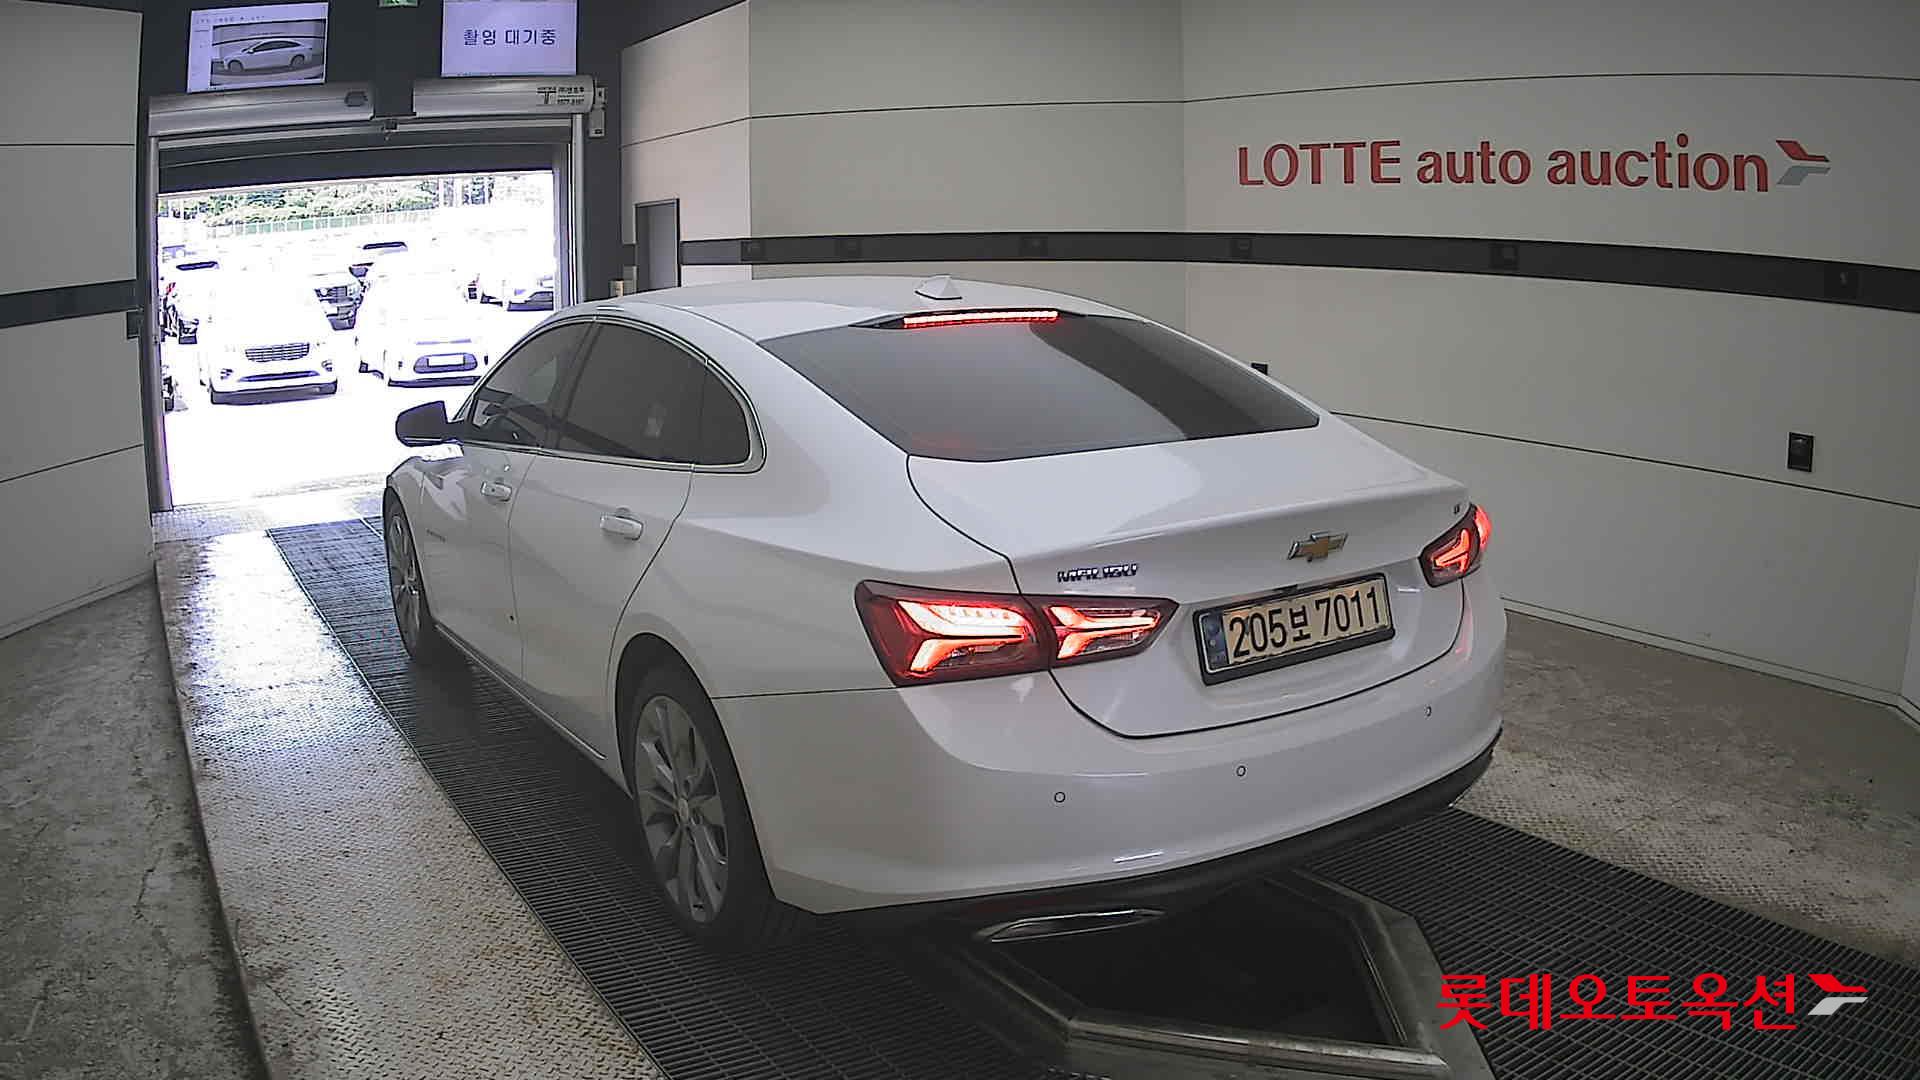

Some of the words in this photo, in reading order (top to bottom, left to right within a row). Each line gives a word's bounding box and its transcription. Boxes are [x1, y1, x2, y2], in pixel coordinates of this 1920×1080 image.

[504, 28, 556, 46] 대기중
[1238, 140, 1401, 187] LOTTE
[1416, 141, 1531, 184] auto
[1547, 133, 1768, 193] auction
